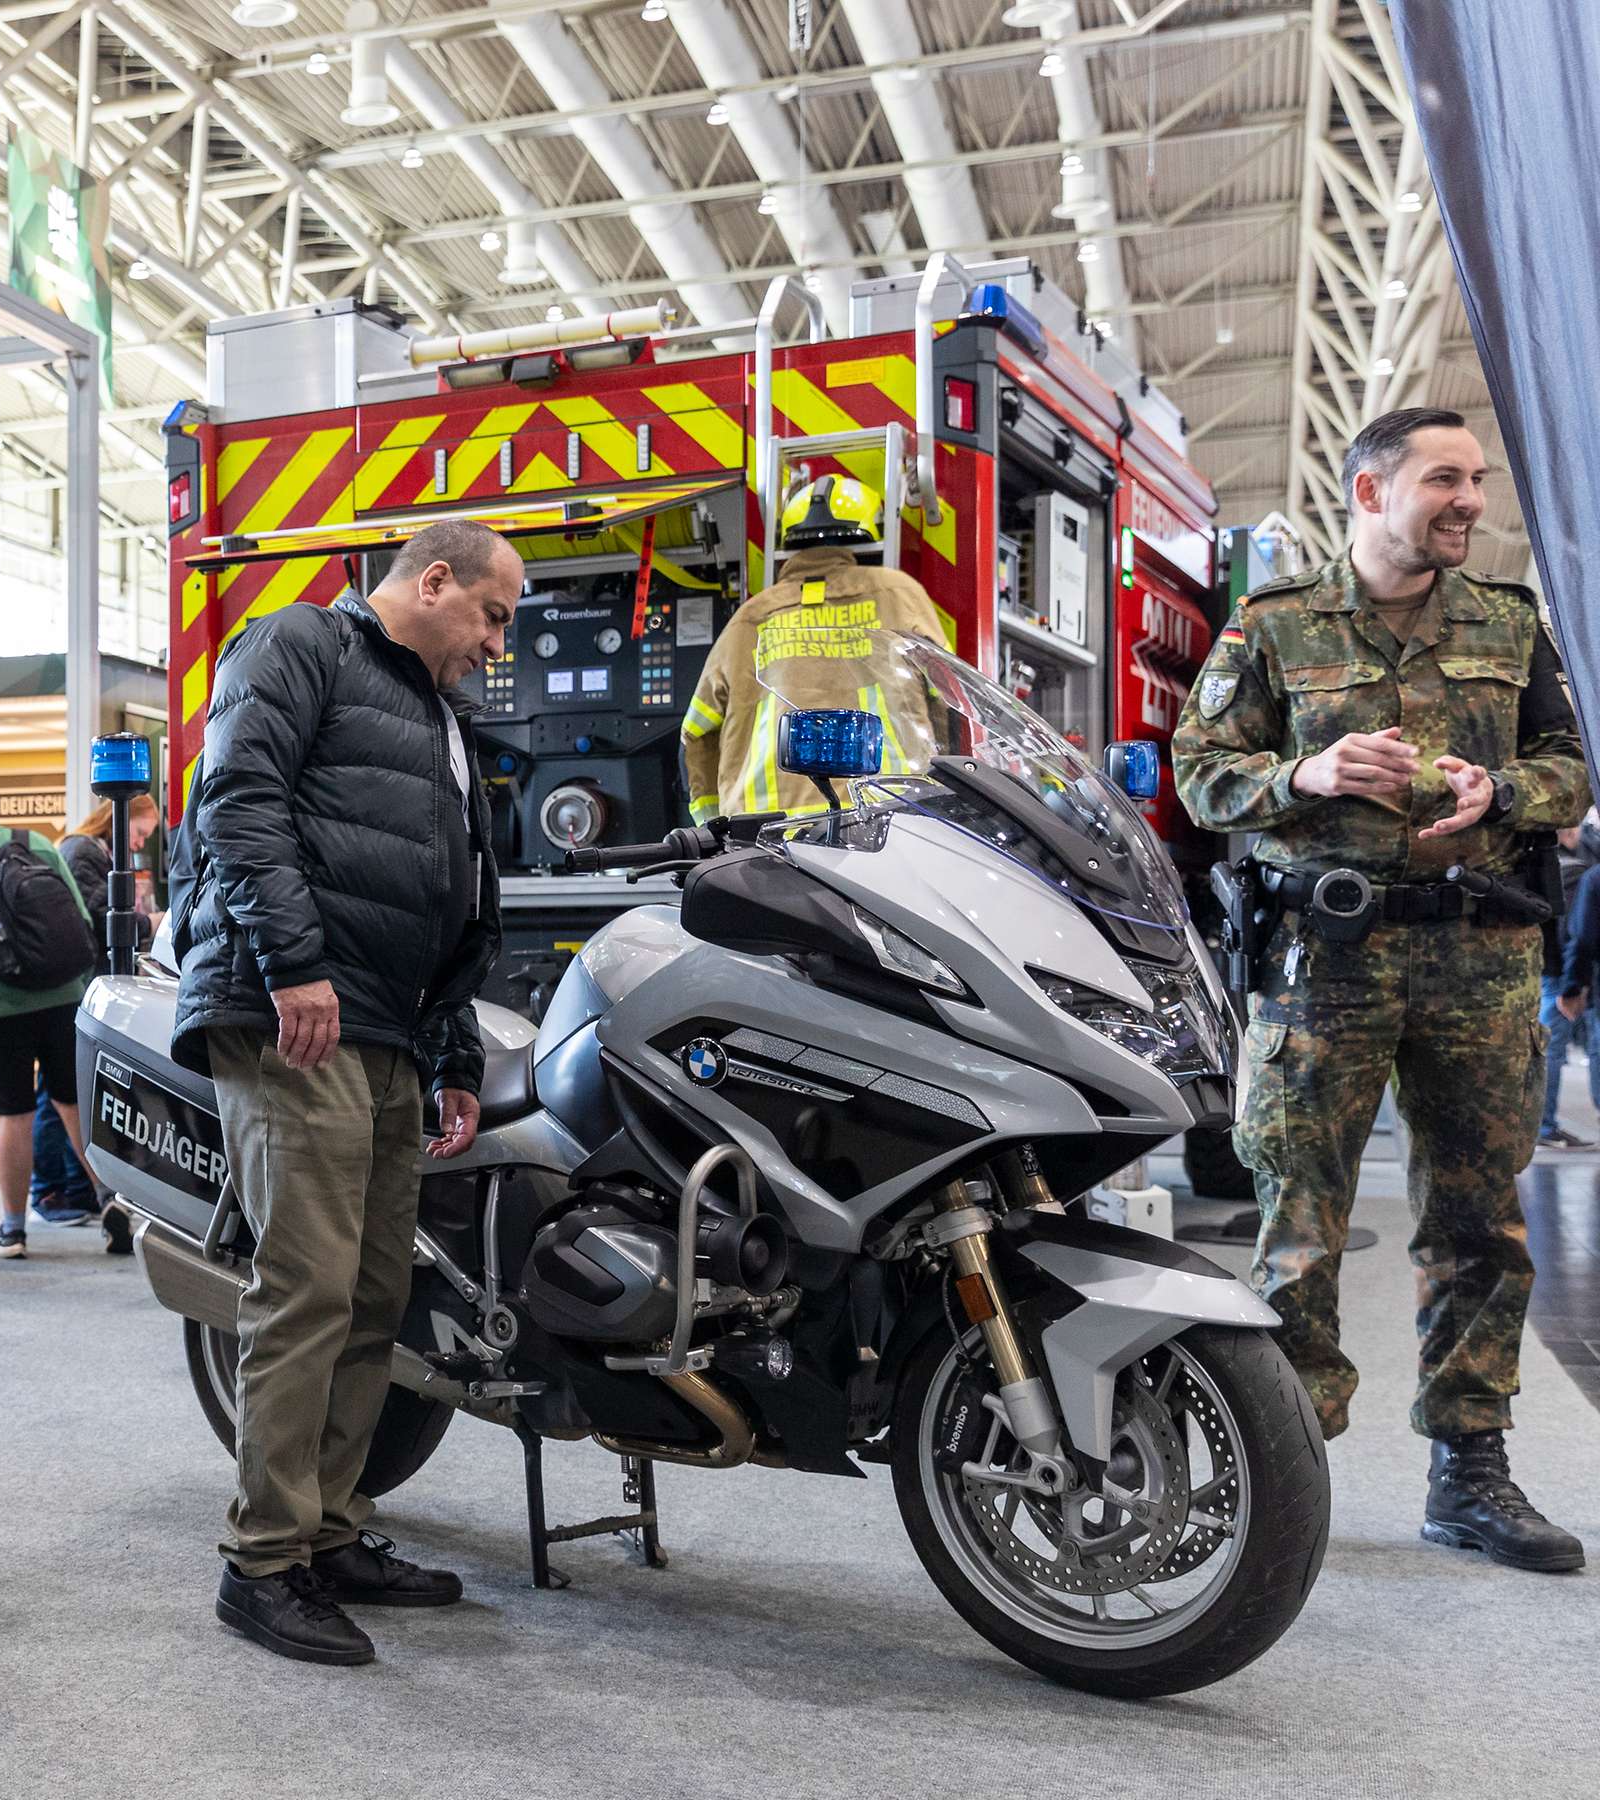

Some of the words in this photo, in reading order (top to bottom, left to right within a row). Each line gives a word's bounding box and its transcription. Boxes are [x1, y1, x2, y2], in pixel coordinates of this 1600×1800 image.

[105, 1062, 124, 1080] BMW
[101, 1090, 227, 1187] FELDJÄGER
[946, 1405, 969, 1453] brembo
